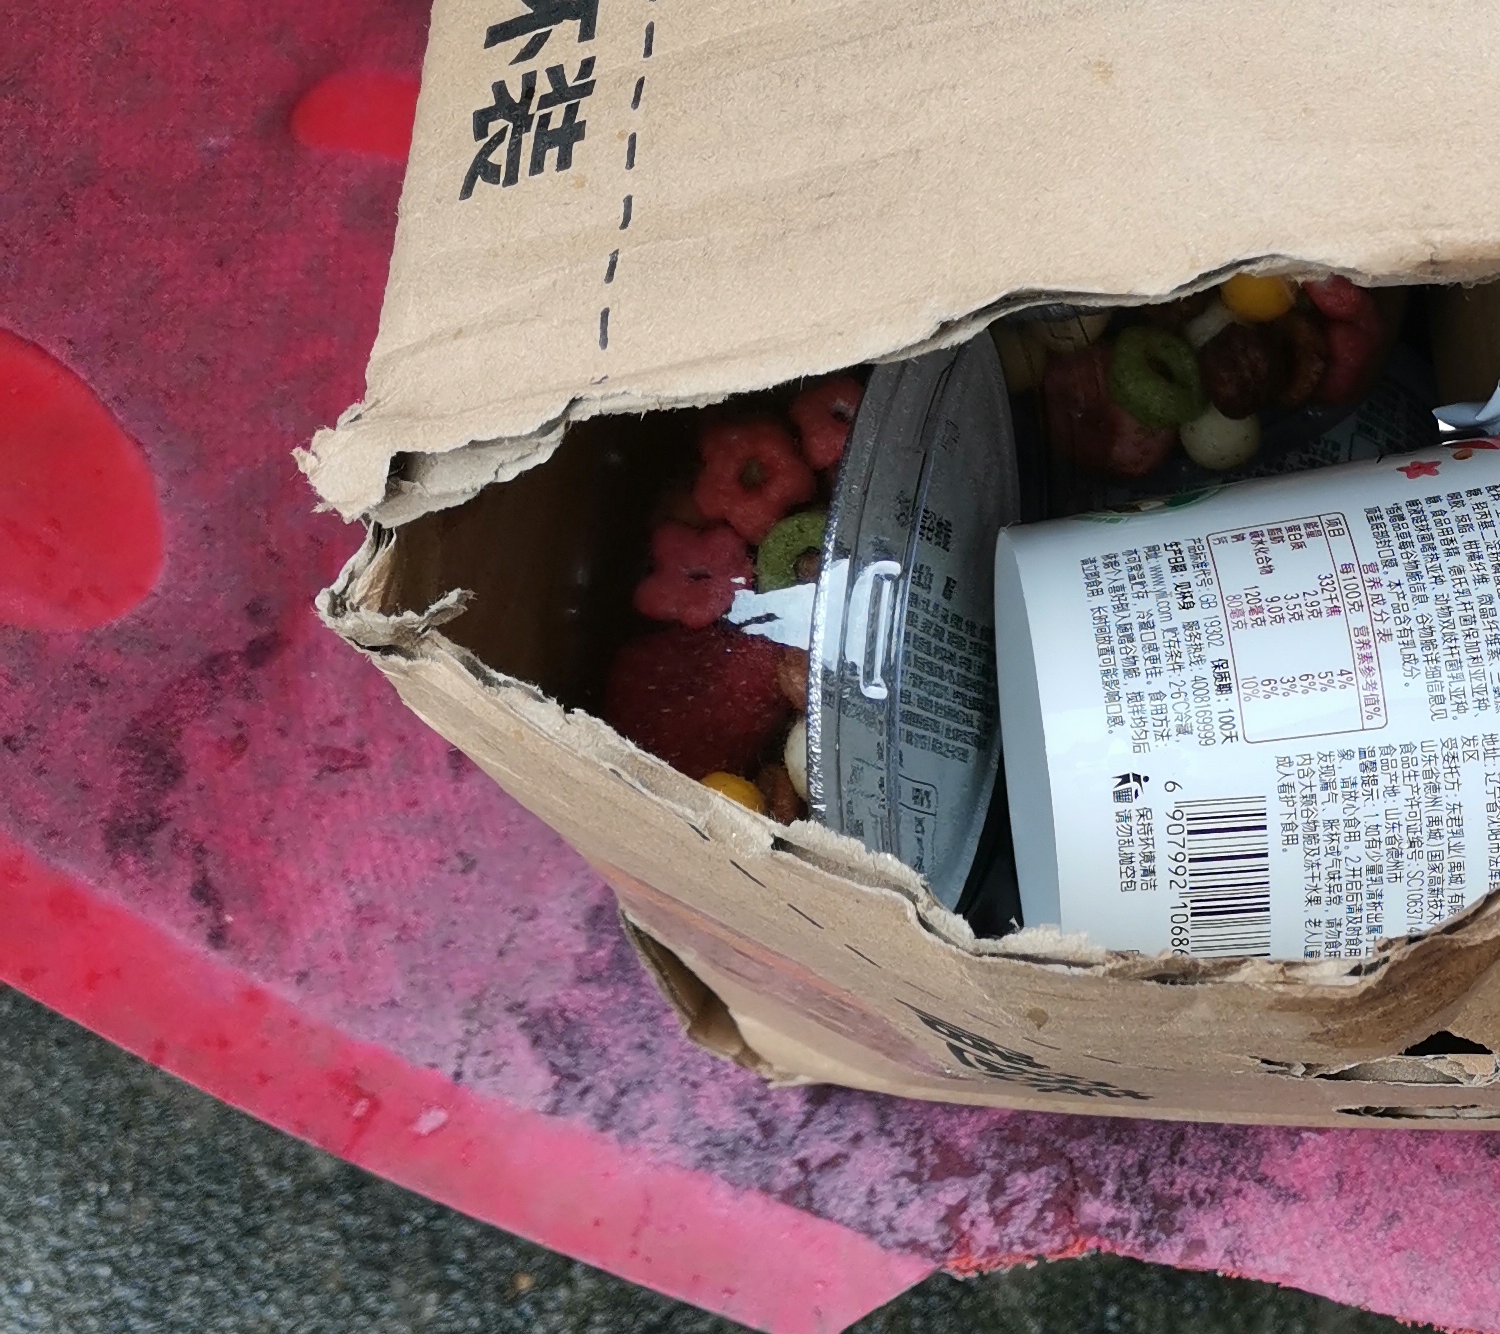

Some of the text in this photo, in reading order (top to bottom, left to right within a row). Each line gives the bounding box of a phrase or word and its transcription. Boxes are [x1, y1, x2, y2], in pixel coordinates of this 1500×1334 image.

[1201, 614, 1224, 649] 19302
[1224, 592, 1248, 632] 80毫克
[1239, 674, 1261, 703] 10%
[1242, 583, 1267, 629] 120毫克
[1259, 677, 1279, 700] 6%
[1264, 594, 1285, 627] 9.0克
[1278, 674, 1298, 697] 3%
[1282, 591, 1304, 624] 3.5克
[1297, 672, 1317, 695] 6%
[1284, 523, 1335, 693] 蛋白质 2.9克 5%
[1316, 571, 1342, 618] 332千焦
[1335, 666, 1354, 690] 4%
[1324, 516, 1381, 720] 项目 每100克 营养素参考值%
[1361, 560, 1394, 644] 营养成分表
[1163, 779, 1183, 793] 6
[1459, 733, 1480, 763] 发区
[1135, 806, 1157, 891] 保持环境清洁
[1165, 808, 1188, 890] 907992
[1419, 738, 1443, 926] 山东省德州(禹城)国家高新技术
